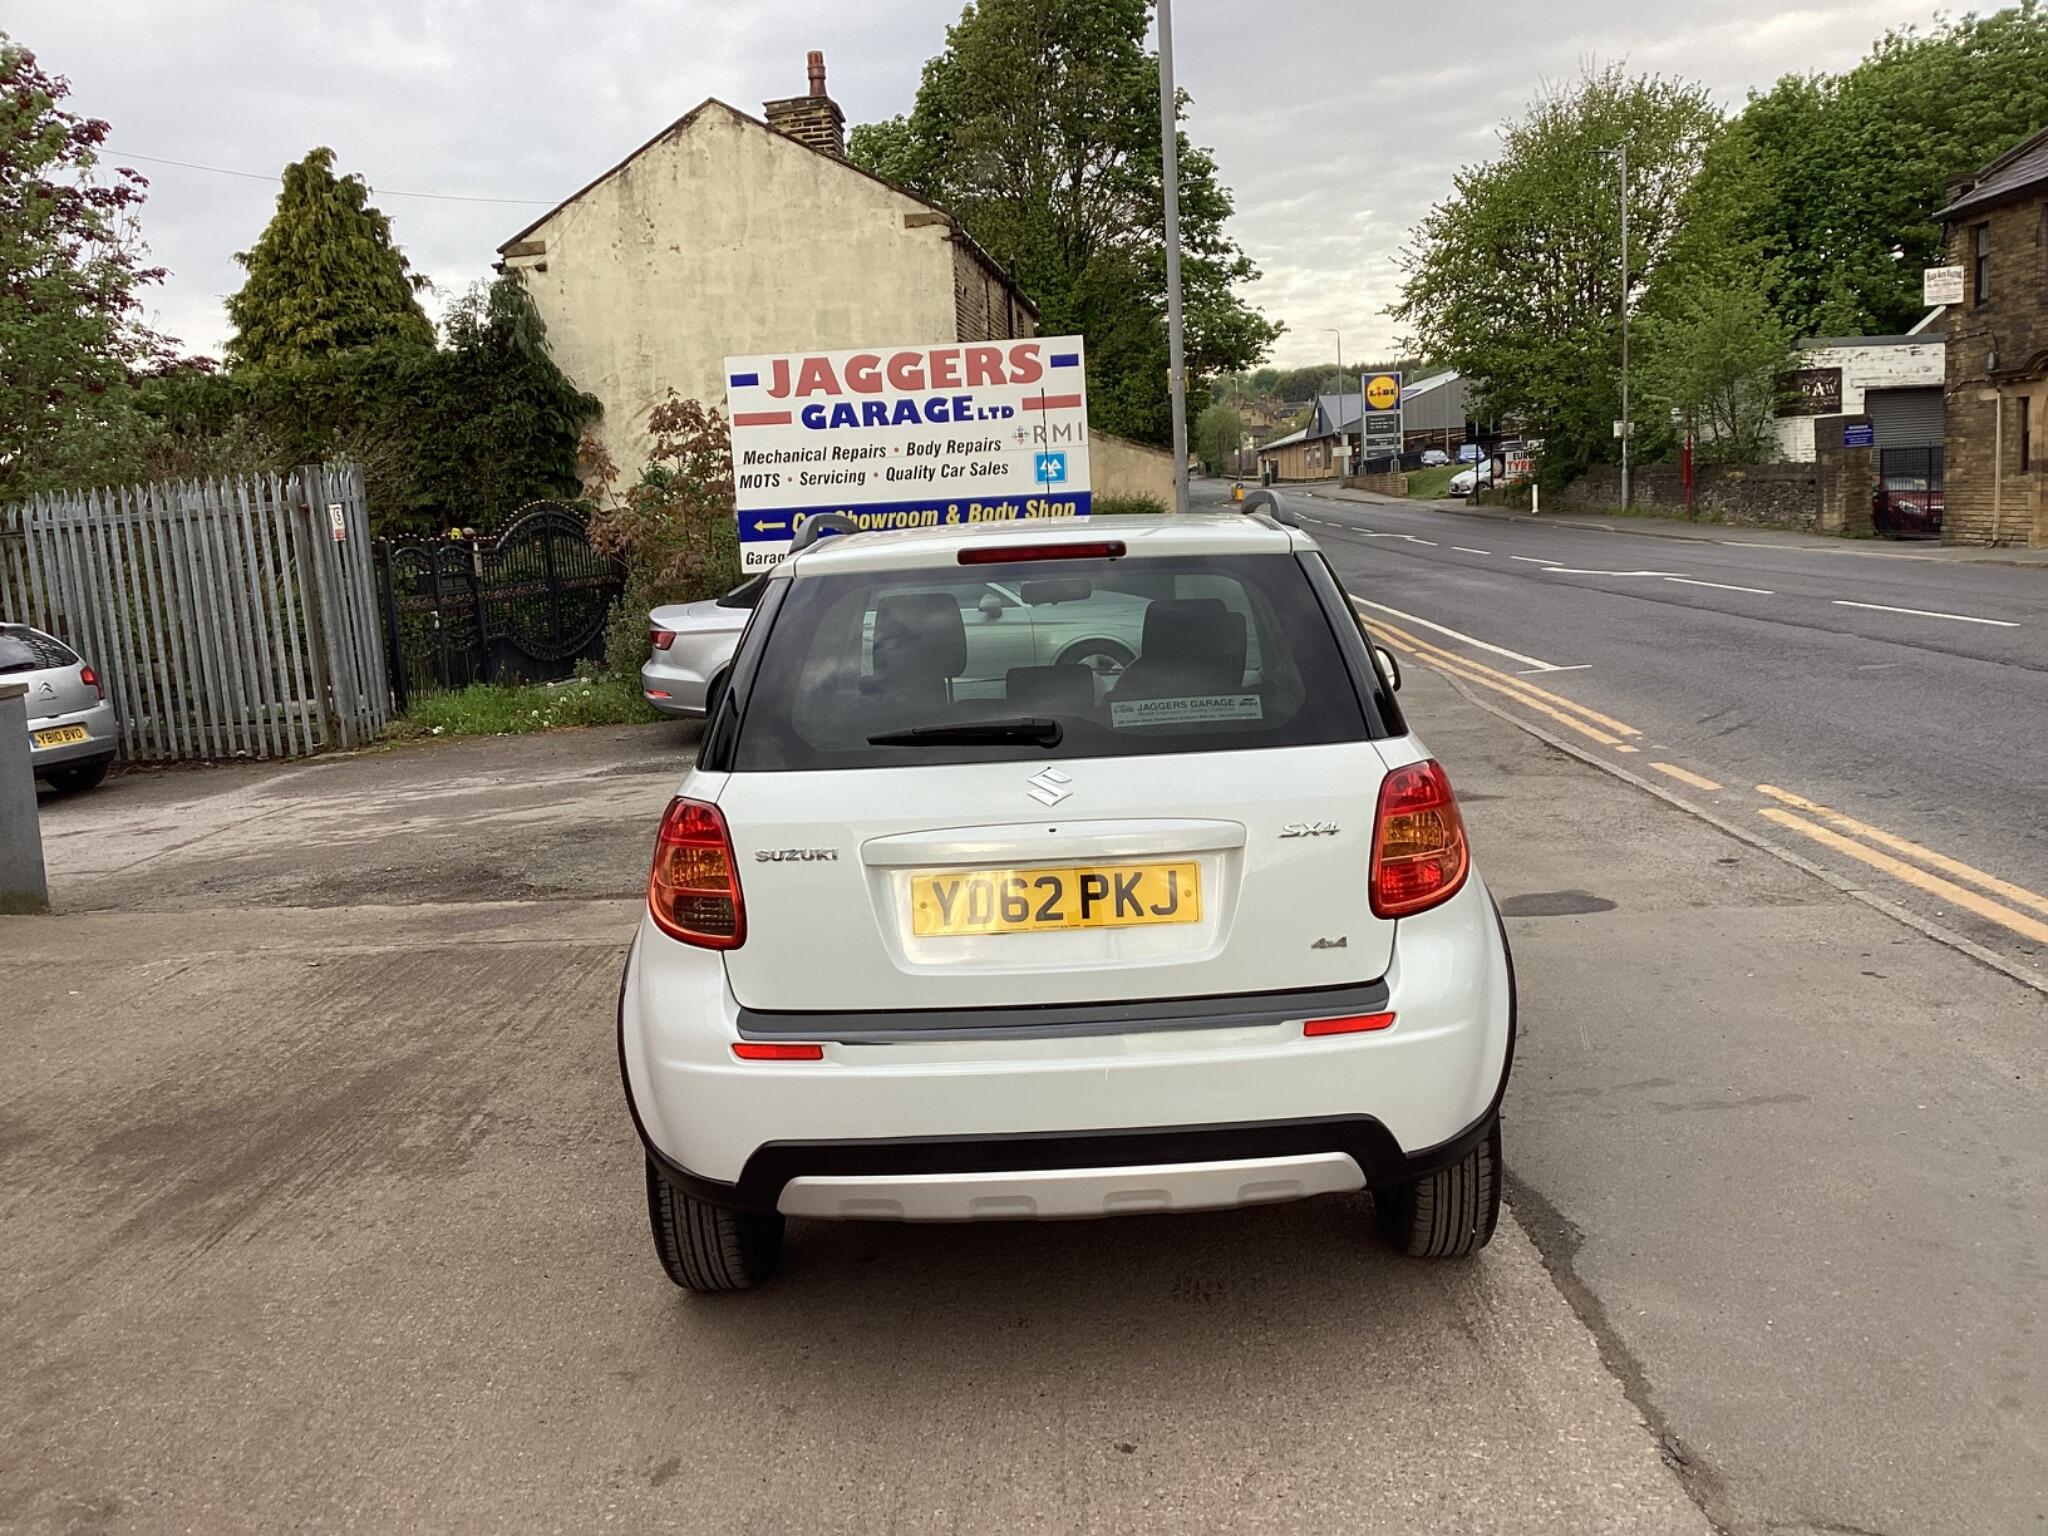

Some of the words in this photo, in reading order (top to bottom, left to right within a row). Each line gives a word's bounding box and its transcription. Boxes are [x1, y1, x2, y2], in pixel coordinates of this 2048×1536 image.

[766, 343, 1044, 399] JAGGERS
[801, 395, 975, 430] GARAGE
[977, 404, 1015, 420] LTD
[1033, 422, 1084, 444] RMI
[742, 446, 827, 466] Mechanical
[831, 443, 887, 463] Repairs
[906, 440, 942, 458] Body
[946, 437, 1002, 455] Repairs
[739, 472, 781, 489] MOTS
[799, 469, 866, 487] Servicing
[885, 463, 936, 482] Quality
[940, 462, 966, 479] Car
[969, 460, 1009, 477] Sales
[945, 503, 961, 525] &
[968, 500, 1019, 523] Body
[1024, 498, 1077, 519] Shop
[1137, 701, 1188, 711] JAGGERS
[1190, 698, 1235, 709] GARAGE
[1279, 821, 1342, 838] SX4
[754, 849, 839, 863] SUZUKI
[932, 873, 1065, 927] YD62
[1079, 869, 1179, 921] PKJ
